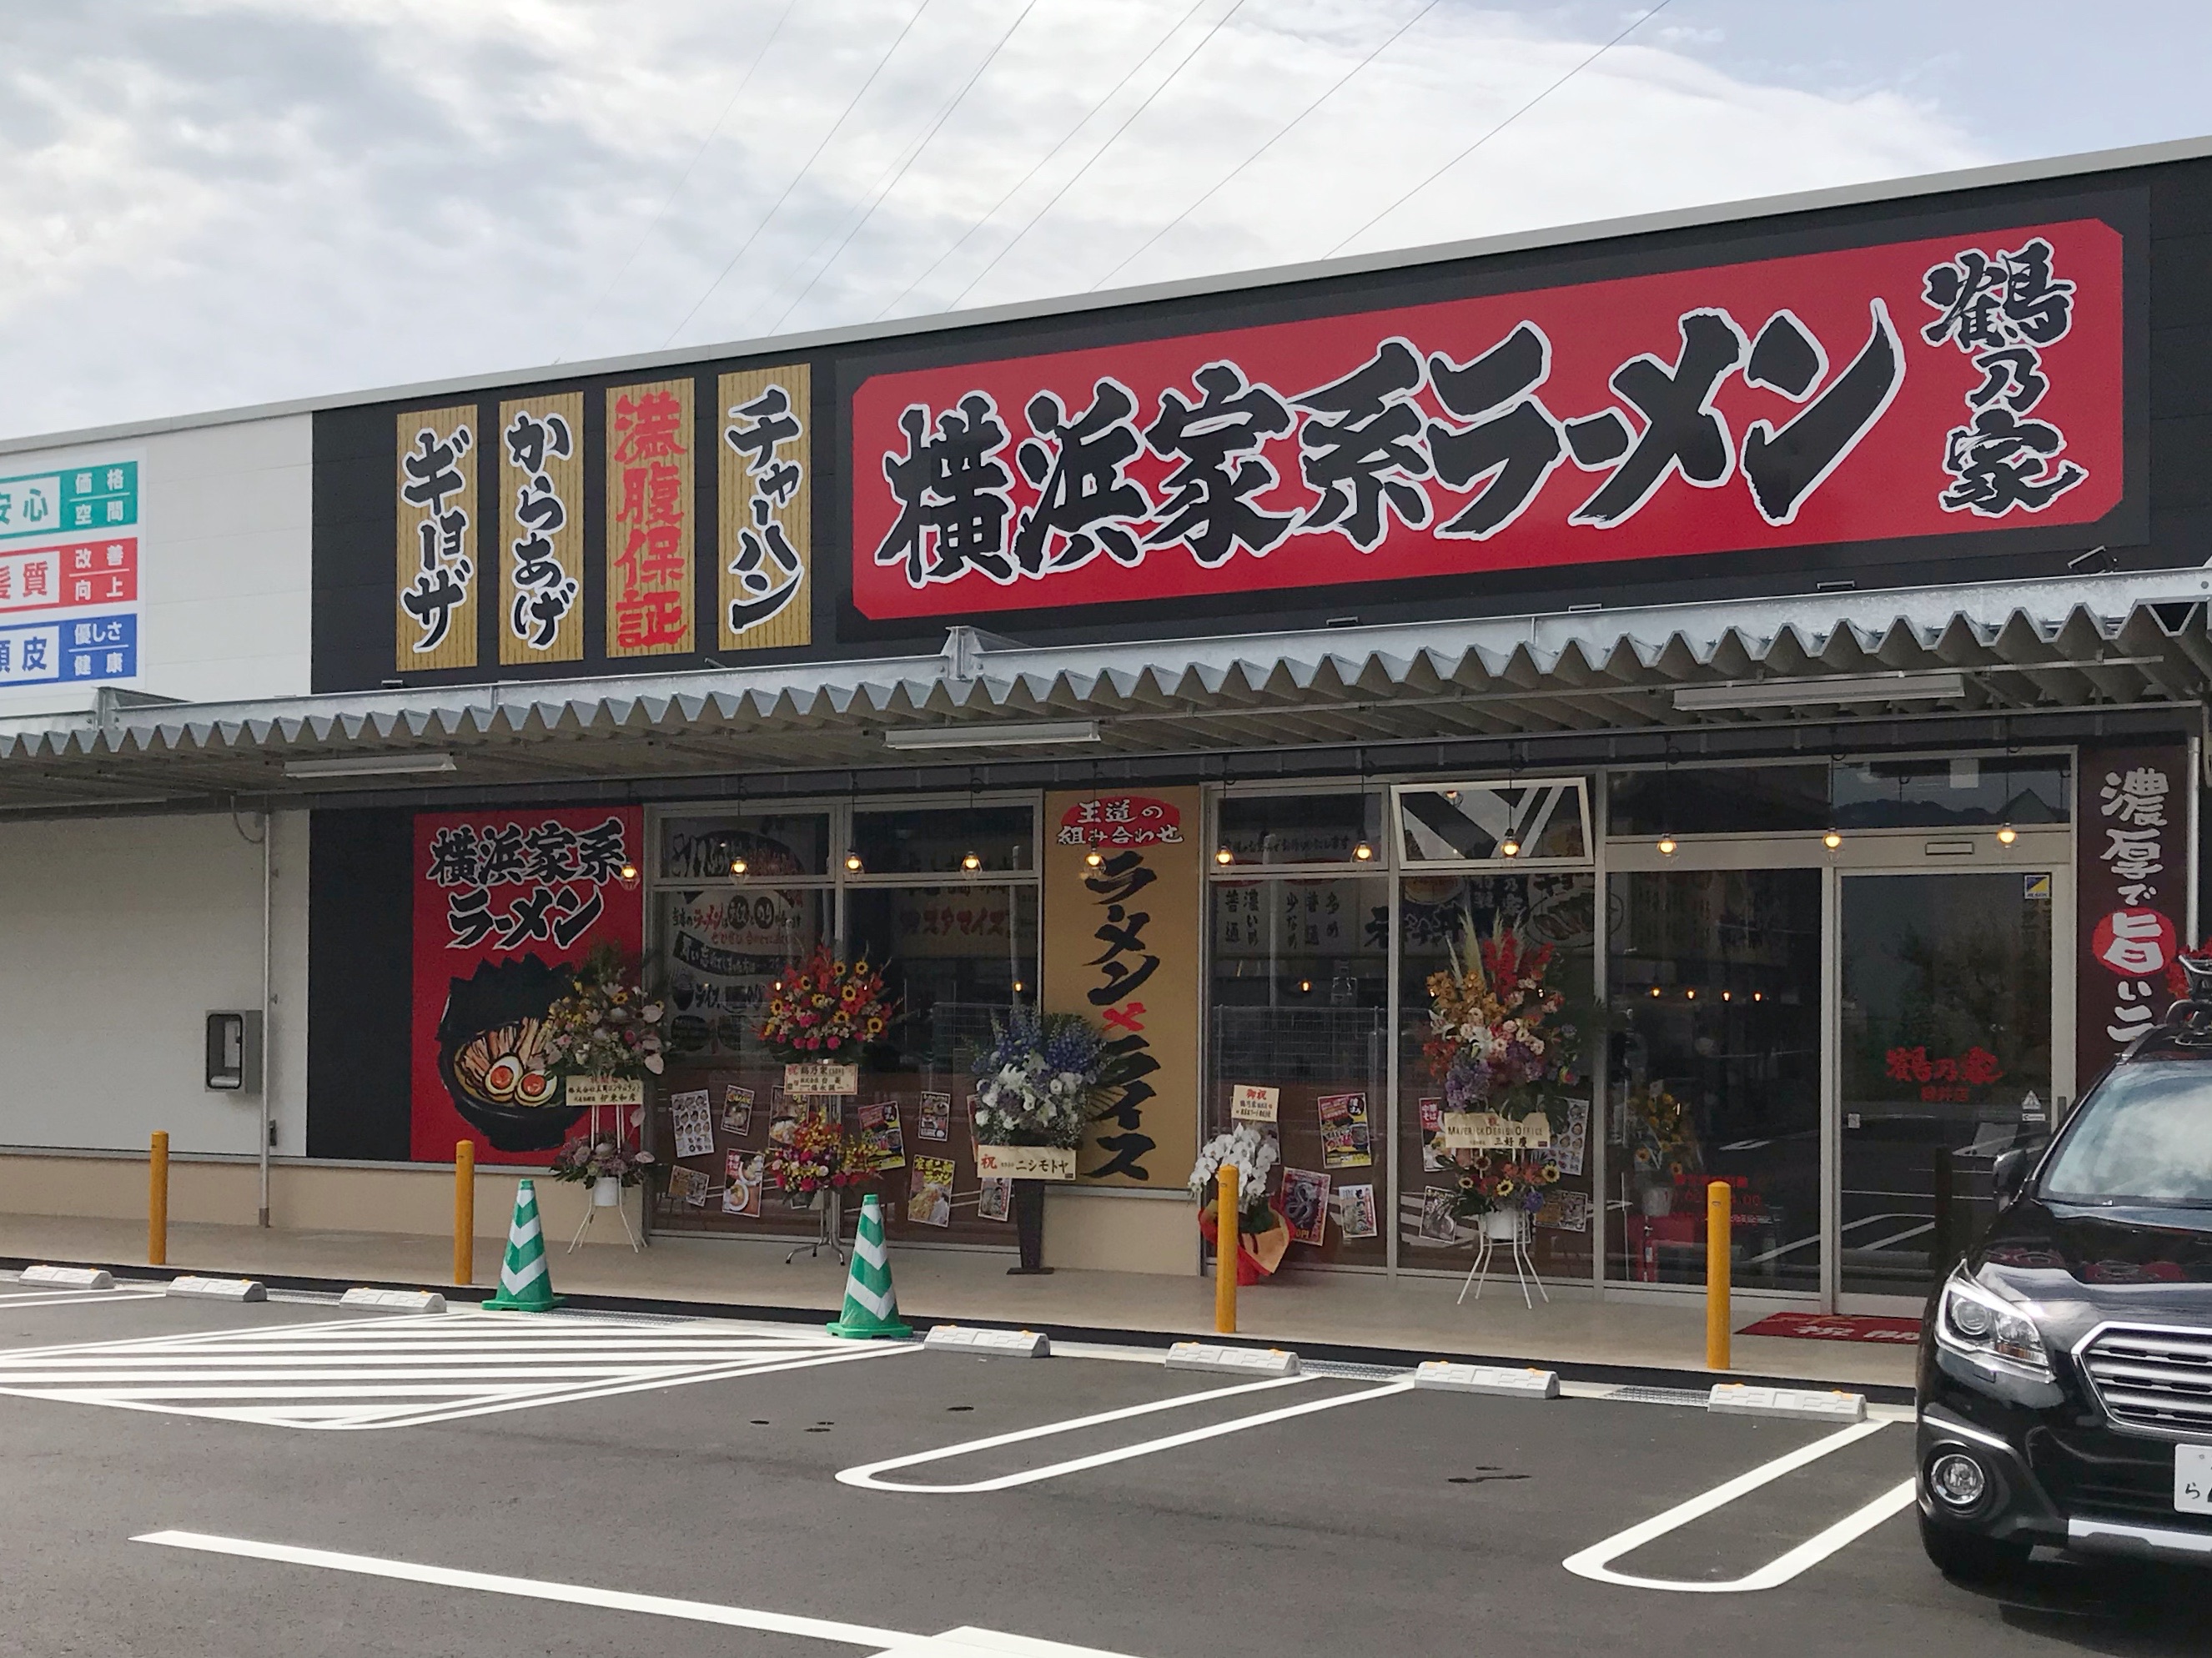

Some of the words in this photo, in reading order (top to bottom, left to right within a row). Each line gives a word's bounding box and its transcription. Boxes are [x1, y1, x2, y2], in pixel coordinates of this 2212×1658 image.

[1921, 237, 2089, 518] 鶴乃家
[875, 296, 1906, 589] 横浜家系ラーメン
[75, 469, 124, 494] 価格
[75, 500, 124, 525] 空間
[614, 390, 688, 648] 満腹保証
[726, 384, 804, 634] チャーハン
[401, 425, 474, 652] ギョーザ
[505, 410, 579, 651] からあげ
[75, 545, 124, 569] 改善
[75, 576, 124, 600] 向上
[74, 621, 123, 645] 優しさ
[74, 651, 123, 676] 健康
[1076, 799, 1164, 824] 王道の
[1057, 824, 1184, 846] 組み合わせ
[426, 816, 630, 887] 横浜家系
[445, 885, 605, 950] ラーメン
[1885, 1045, 2005, 1085] 鶴乃家
[1494, 1137, 1514, 1148] 三好
[981, 1154, 998, 1169] 祝
[1016, 1159, 1068, 1173] ニシモトヤ
[2185, 1482, 2200, 1500] ら
